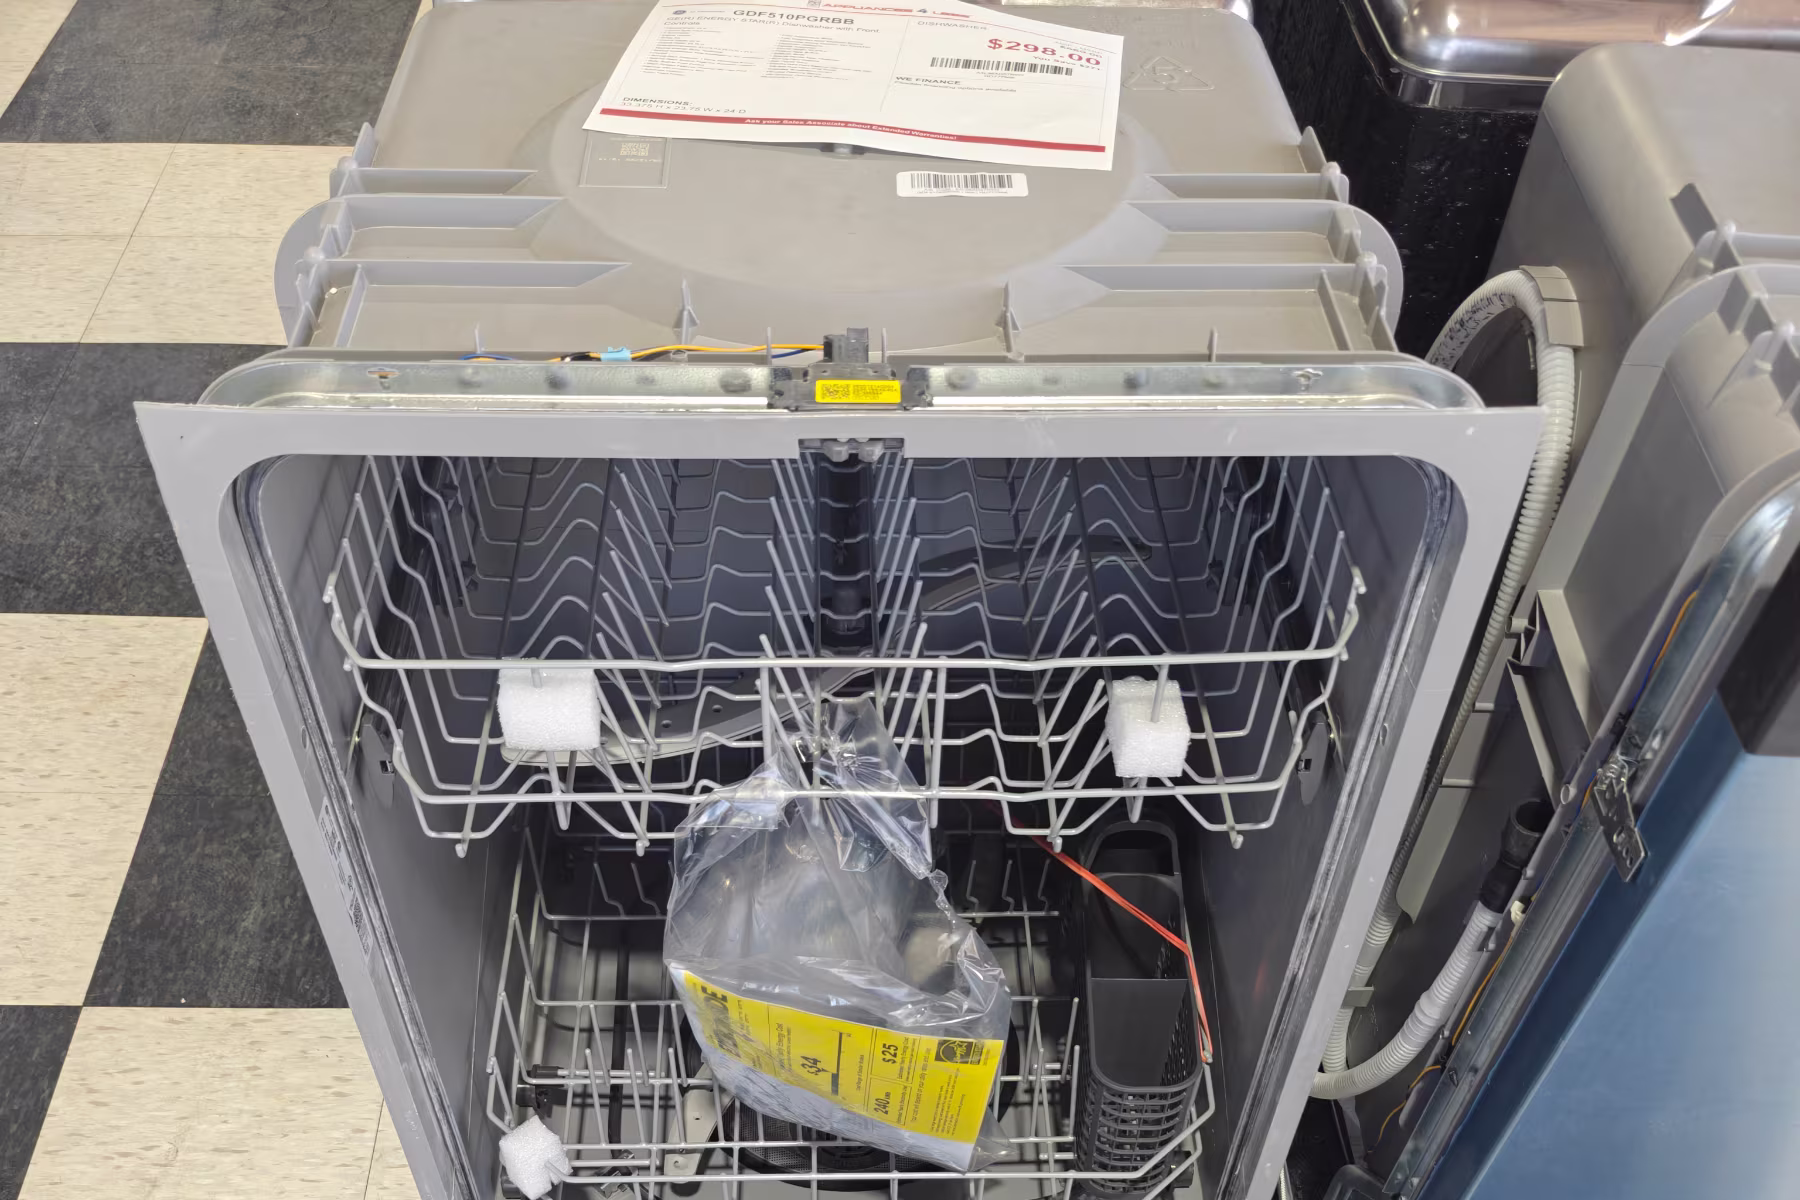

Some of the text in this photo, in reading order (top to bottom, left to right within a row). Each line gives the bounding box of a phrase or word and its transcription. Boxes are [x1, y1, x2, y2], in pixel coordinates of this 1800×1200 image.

[733, 9, 854, 25] GDF510PGRBB
[917, 21, 988, 30] DISHWASHER
[986, 38, 1101, 66] $298.00
[915, 77, 961, 85] FINANCE
[622, 97, 693, 106] DIMENSIONS:
[871, 125, 911, 134] Extended
[881, 1043, 899, 1064] $25
[873, 1098, 890, 1115] 240
